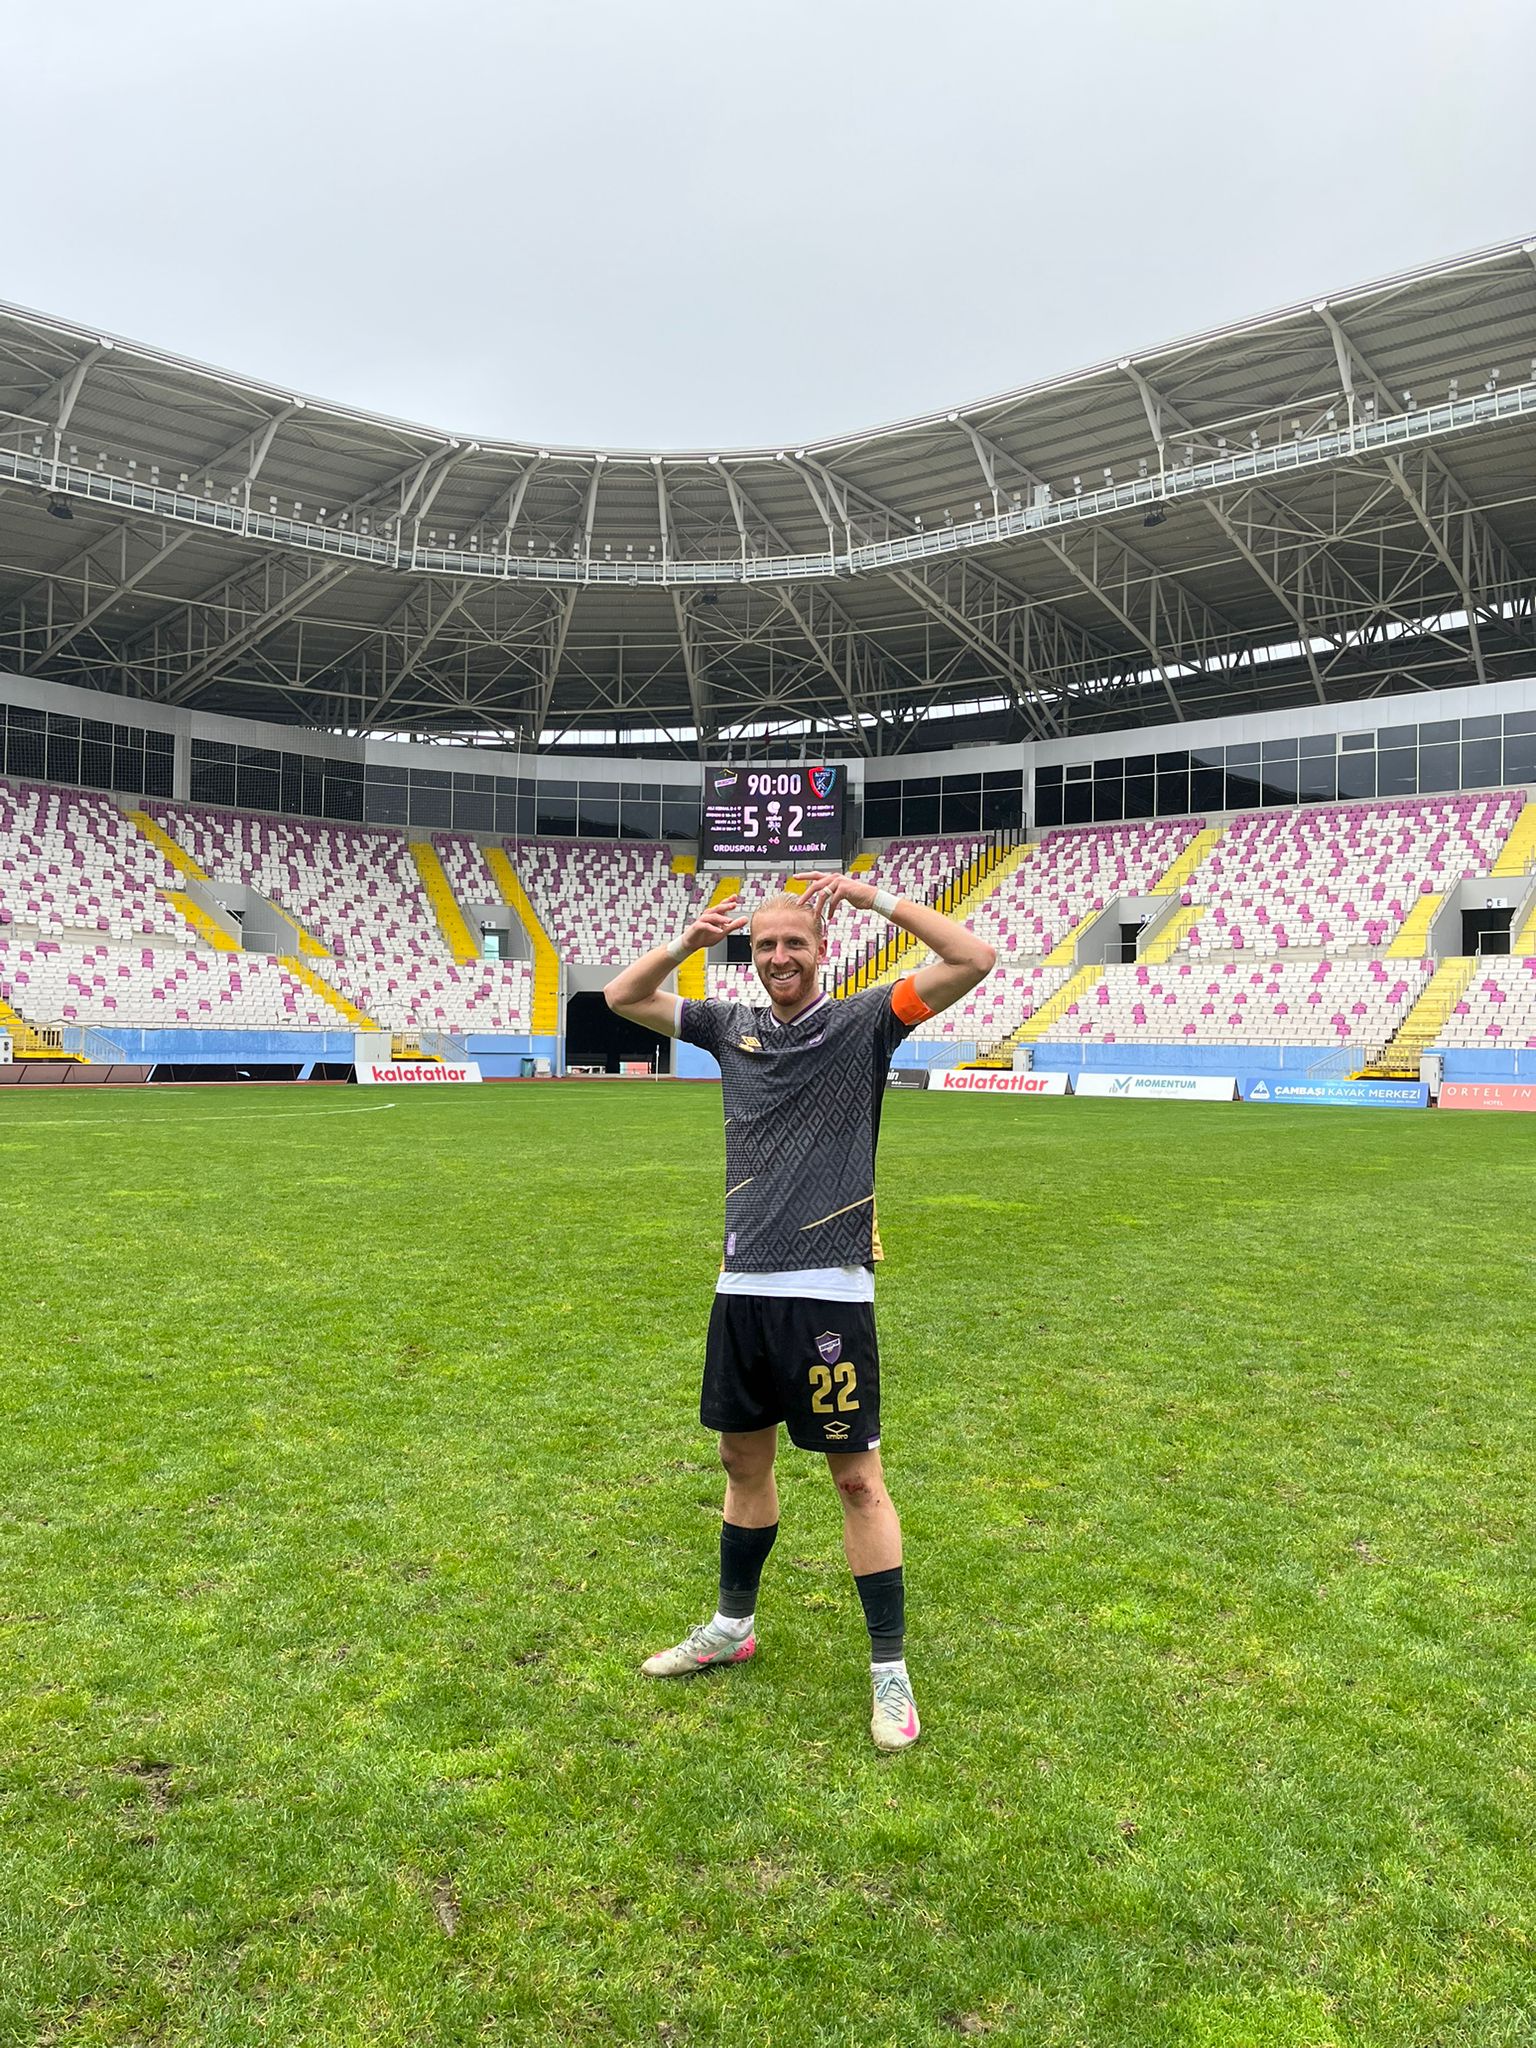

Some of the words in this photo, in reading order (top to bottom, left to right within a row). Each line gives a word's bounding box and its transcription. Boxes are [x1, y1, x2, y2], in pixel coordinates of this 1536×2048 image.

[747, 774, 801, 795] 90:00
[744, 806, 759, 837] 5
[787, 805, 803, 838] 2
[713, 844, 755, 853] ORDUSPOR
[757, 844, 768, 854] AŞ
[789, 843, 819, 852] KARABÜK
[372, 1065, 466, 1082] kalafatlar
[943, 1072, 1049, 1092] kalafatlar
[1134, 1079, 1197, 1089] MOMENTUM
[1274, 1086, 1325, 1097] ÇAMBAŞI
[1327, 1087, 1365, 1097] KAYAK
[1368, 1088, 1421, 1099] MERKEZİ
[1447, 1086, 1501, 1097] ORTEL
[808, 1361, 860, 1414] 22
